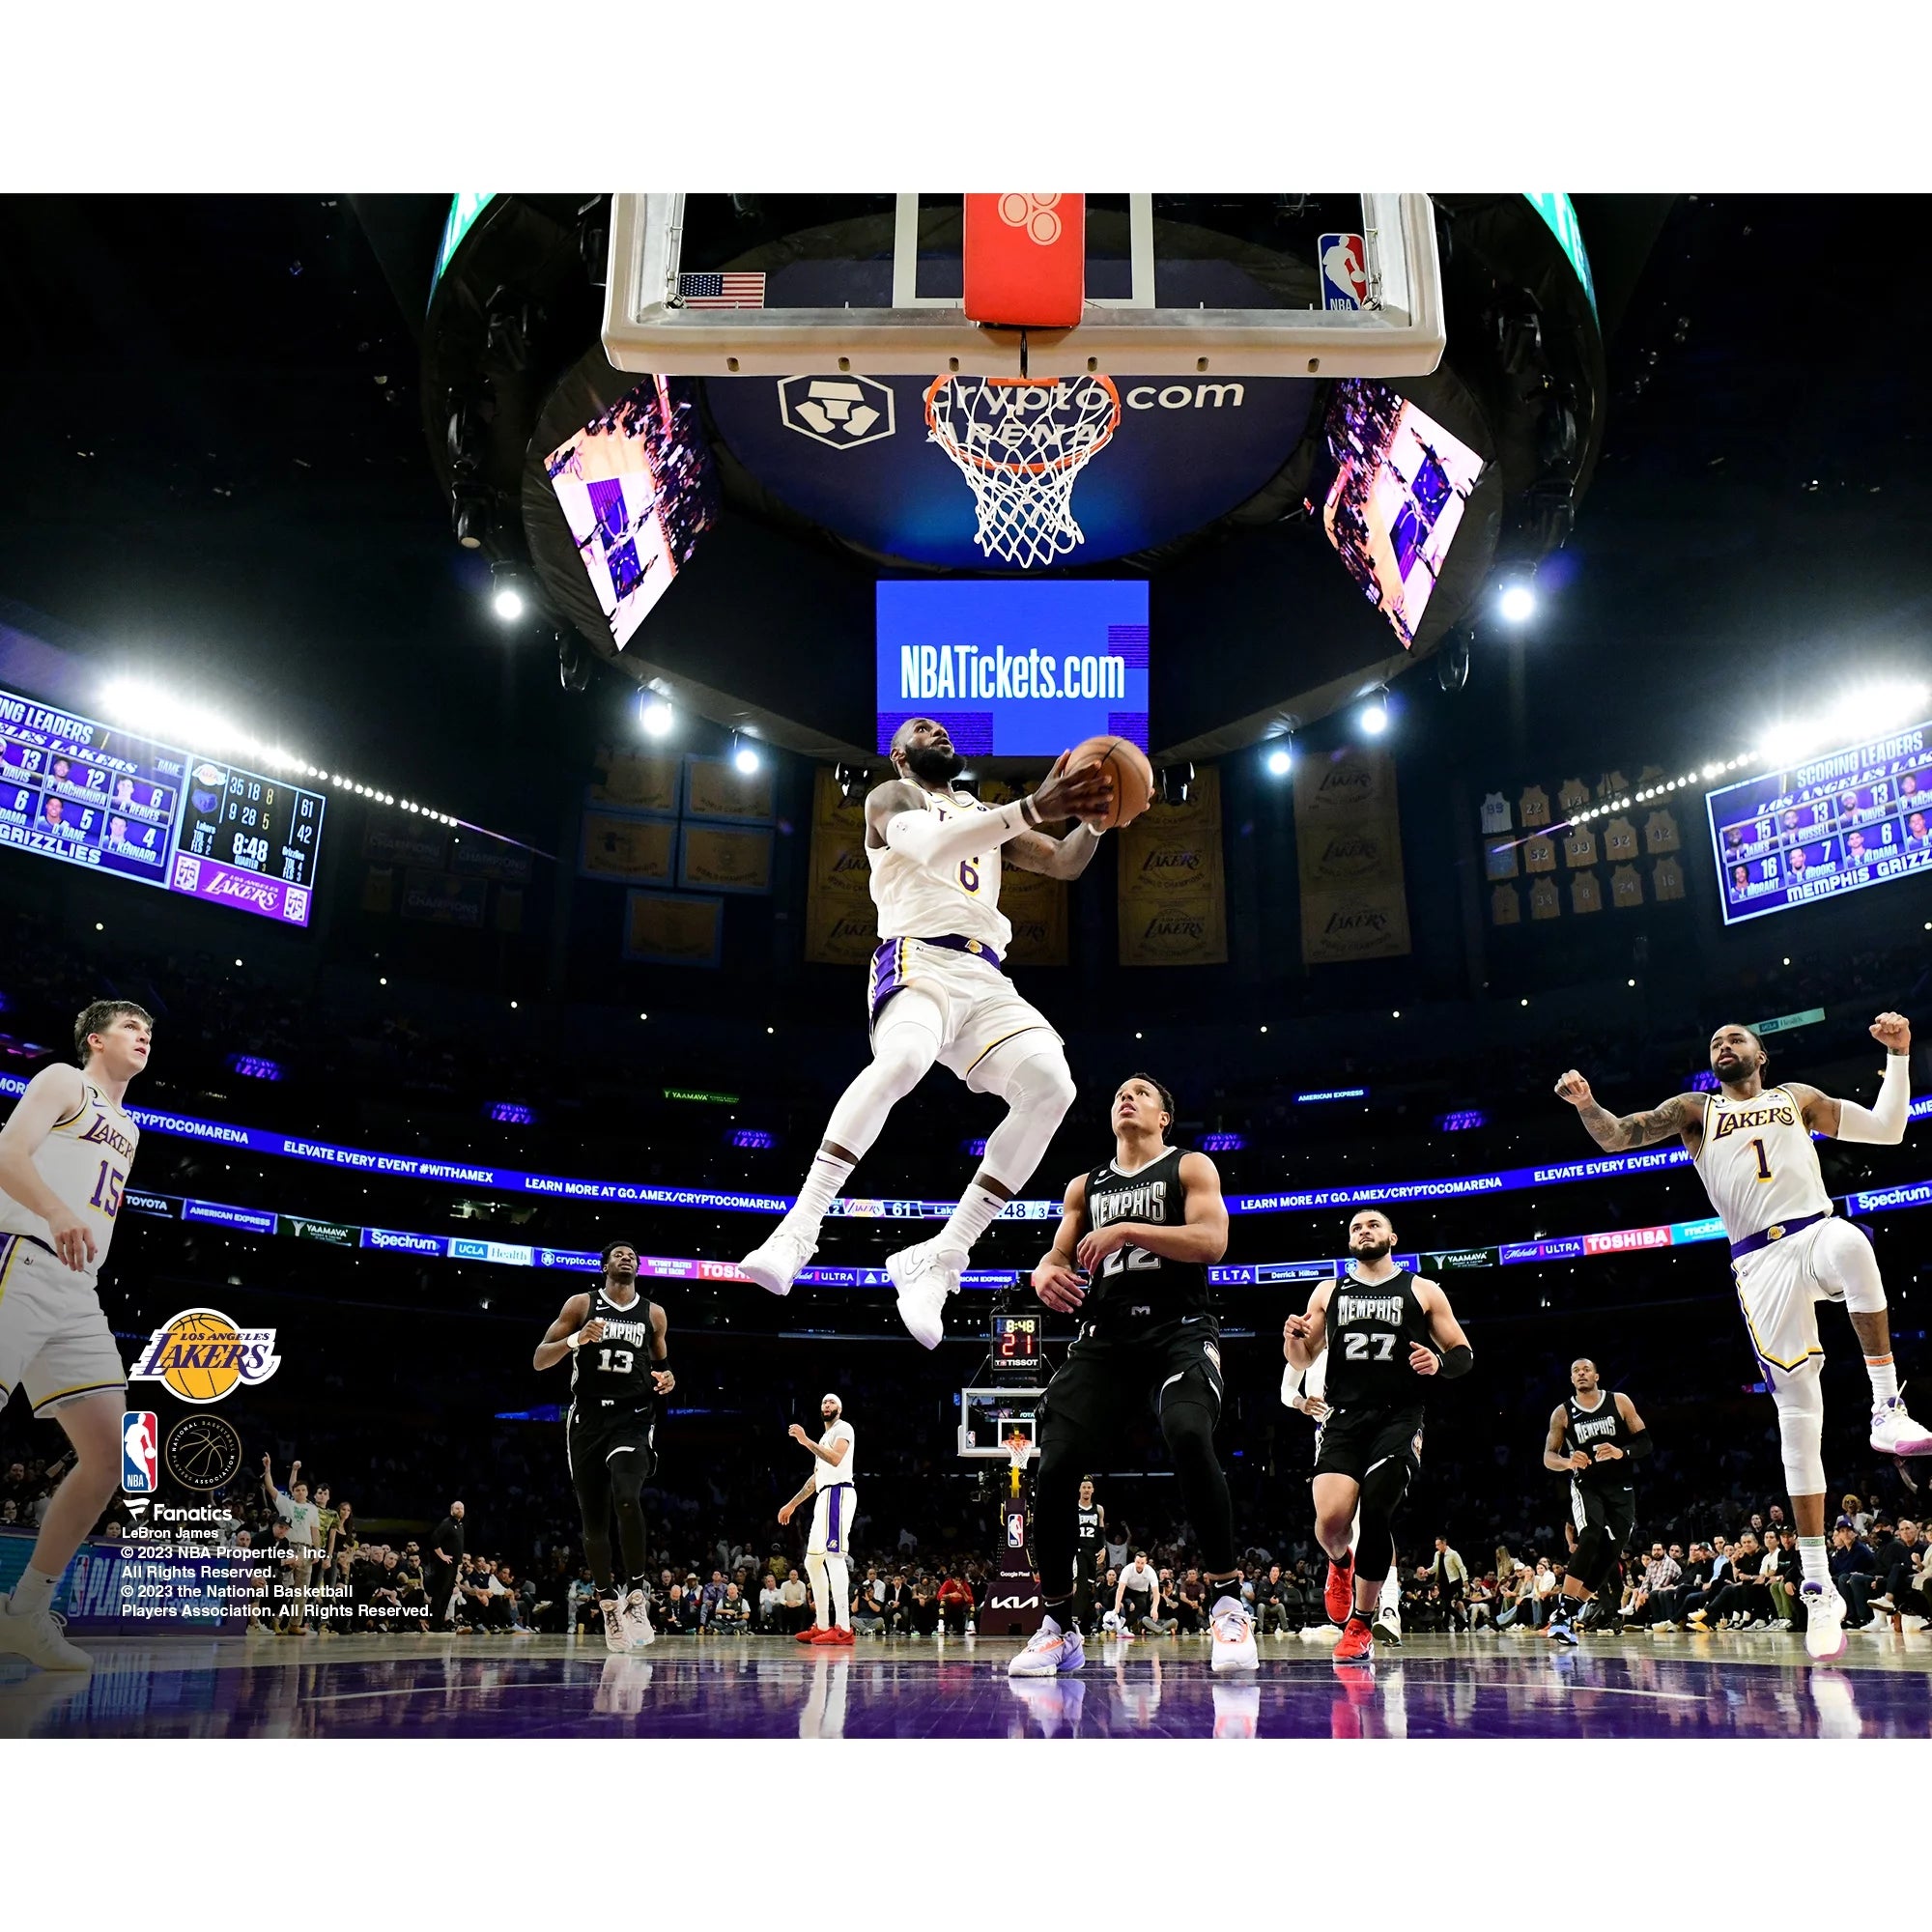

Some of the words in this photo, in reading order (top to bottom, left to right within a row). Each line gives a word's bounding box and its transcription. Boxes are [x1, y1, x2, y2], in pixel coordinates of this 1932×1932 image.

[1330, 298, 1352, 310] NBA
[922, 382, 1245, 415] cryptocom
[924, 422, 1101, 445] ARENA
[901, 644, 1124, 699] NBATickets.com
[24, 706, 94, 745] LEADERS
[21, 749, 42, 771] 13
[50, 739, 138, 774] LAKERS
[1799, 755, 1859, 788] SCORING
[1861, 731, 1923, 767] LEADERS
[86, 768, 105, 790] 12
[1800, 766, 1887, 801] ANGELES
[14, 790, 30, 810] 6
[150, 788, 163, 809] 6
[230, 777, 243, 795] 35
[247, 782, 261, 801] 18
[266, 788, 274, 805] 8
[300, 799, 314, 818] 61
[1870, 783, 1889, 804] 13
[79, 809, 95, 830] 5
[1811, 802, 1829, 822] 13
[228, 803, 238, 820] 9
[242, 807, 257, 826] 28
[262, 812, 270, 830] 5
[297, 824, 313, 844] 42
[1755, 820, 1771, 840] 15
[1882, 823, 1891, 843] 6
[0, 823, 102, 865] GRIZZLIES
[143, 828, 156, 848] 4
[232, 832, 269, 862] 8:48
[1572, 841, 1590, 854] 33
[1612, 836, 1631, 848] 32
[1530, 848, 1548, 860] 52
[1822, 840, 1832, 862] 7
[959, 856, 980, 893] 6
[1761, 857, 1777, 879] 16
[202, 871, 280, 911] LAKERS
[1787, 867, 1870, 903] MEMPHIS
[1298, 1092, 1332, 1101] AMERICAN
[1333, 1089, 1364, 1099] EXPRESS
[1713, 1105, 1795, 1141] LAKERS
[283, 1140, 335, 1161] ELEVATE
[336, 1150, 377, 1168] EVERY
[378, 1157, 418, 1174] EVENT
[419, 1162, 494, 1183] #WITHAMEX
[1751, 1138, 1773, 1180] 1
[90, 1159, 125, 1218] 15
[1240, 1198, 1278, 1211] LEARN
[1280, 1195, 1314, 1208] MORE
[1315, 1192, 1329, 1205] AT
[1330, 1190, 1351, 1204] GO.
[1352, 1177, 1502, 1203] AMEX/CRYPTOCOMARENA
[1534, 1165, 1584, 1182] ELEVATE
[1586, 1159, 1624, 1176] EVERY
[1627, 1153, 1667, 1170] EVENT
[126, 1195, 168, 1210] TOYOTA
[525, 1178, 563, 1192] LEARN
[565, 1182, 600, 1196] MORE
[601, 1186, 617, 1198] AT
[617, 1187, 639, 1200] GO.
[639, 1188, 787, 1211] AMEX/CRYPTOCOMARENA
[1089, 1180, 1167, 1229] MEMPHIS
[1858, 1186, 1931, 1210] Spectrum
[189, 1207, 233, 1221] AMERICAN
[234, 1213, 270, 1227] EXPRESS
[833, 1206, 840, 1214] 2
[892, 1202, 911, 1216] 61
[1038, 1208, 1045, 1217] 3
[371, 1231, 437, 1251] Spectrum
[1546, 1241, 1580, 1254] ULTRA
[1587, 1229, 1668, 1251] TOSHIBA
[458, 1244, 485, 1256] UCLA
[491, 1247, 527, 1262] Health
[821, 1272, 854, 1281] ULTRA
[1211, 1271, 1251, 1282] ELTA
[1271, 1270, 1296, 1280] Derrick
[1338, 1295, 1405, 1326] MEMPHIS
[601, 1321, 645, 1348] EMPHIS
[1006, 1320, 1036, 1333] 8:48
[1002, 1333, 1032, 1356] 21
[1344, 1332, 1397, 1361] 27
[596, 1349, 634, 1374] 13
[1008, 1358, 1039, 1367] TISSOT
[1574, 1415, 1616, 1444] MEMPHIS
[1079, 1526, 1094, 1538] 12
